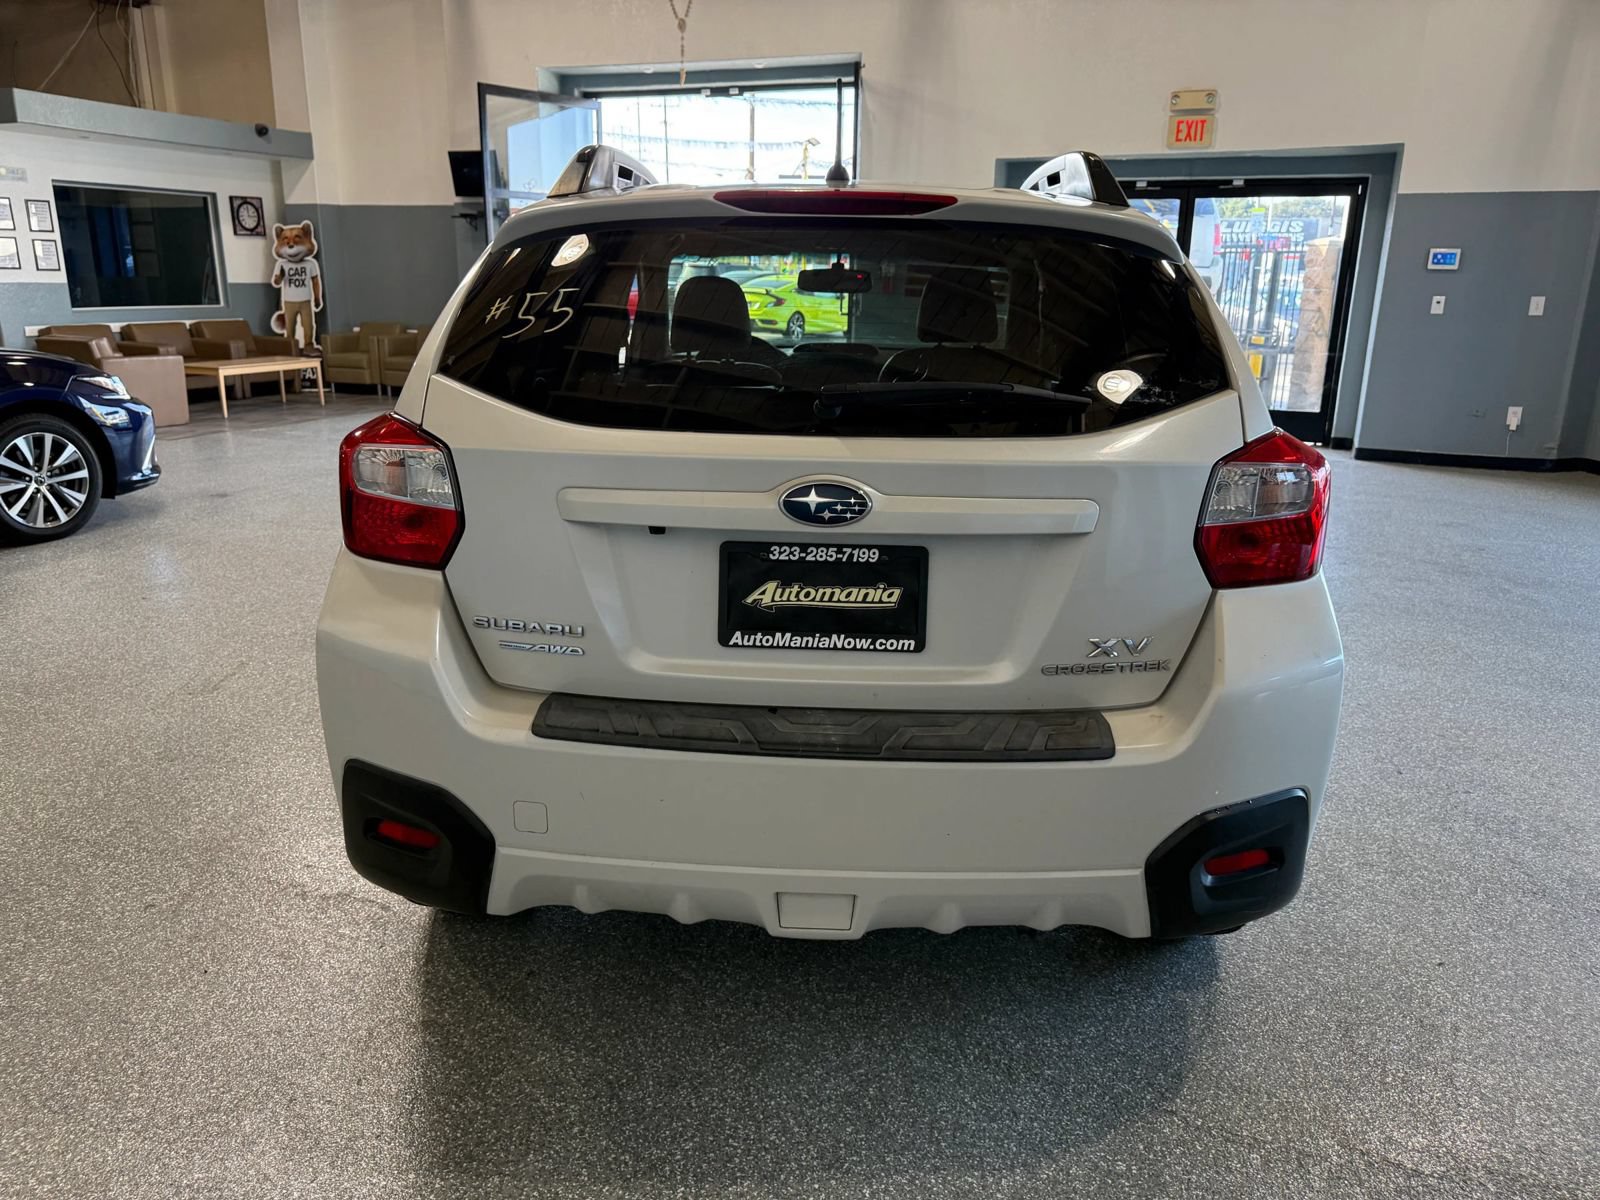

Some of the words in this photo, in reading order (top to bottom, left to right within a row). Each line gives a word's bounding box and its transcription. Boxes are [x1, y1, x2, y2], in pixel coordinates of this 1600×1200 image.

[1175, 119, 1207, 143] EXIT
[287, 267, 307, 278] CAR
[288, 278, 307, 288] FOX
[769, 546, 879, 563] 323-285-7199
[743, 580, 903, 611] Automania
[473, 616, 584, 638] SUBARU
[531, 643, 585, 656] AWD
[728, 631, 916, 651] AutoManiaNow.com
[1086, 637, 1154, 657] XV
[1041, 659, 1170, 676] CROSSTREK
